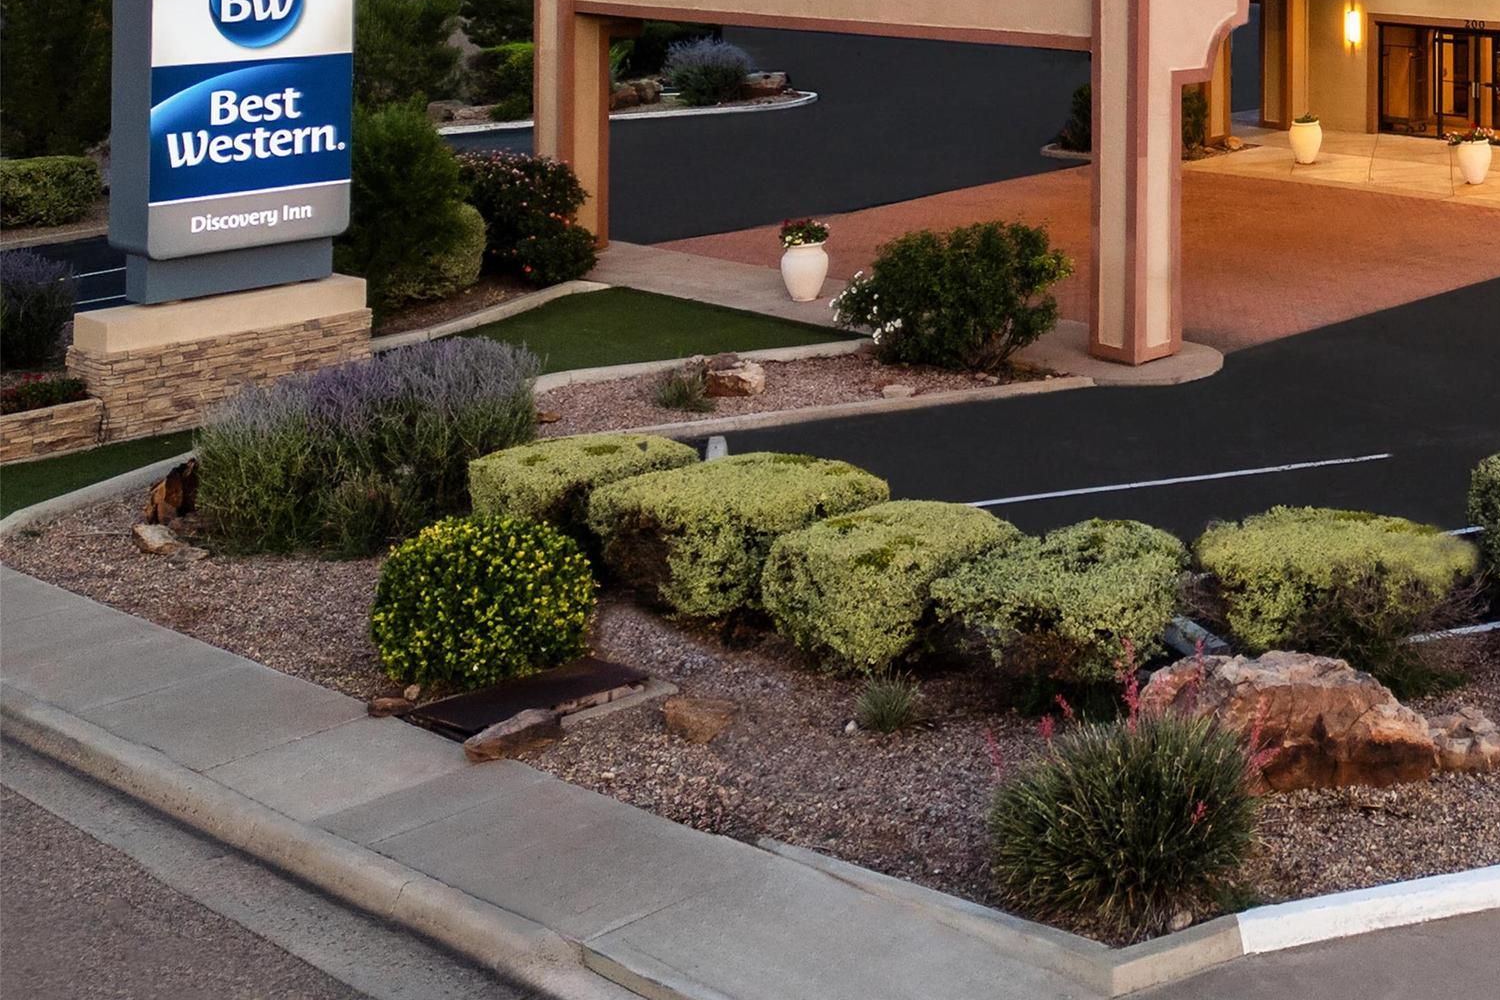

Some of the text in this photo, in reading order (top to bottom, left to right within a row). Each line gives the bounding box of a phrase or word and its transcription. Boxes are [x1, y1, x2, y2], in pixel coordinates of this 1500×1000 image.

[210, 87, 302, 126] Best
[191, 204, 313, 233] Discovery Inn
